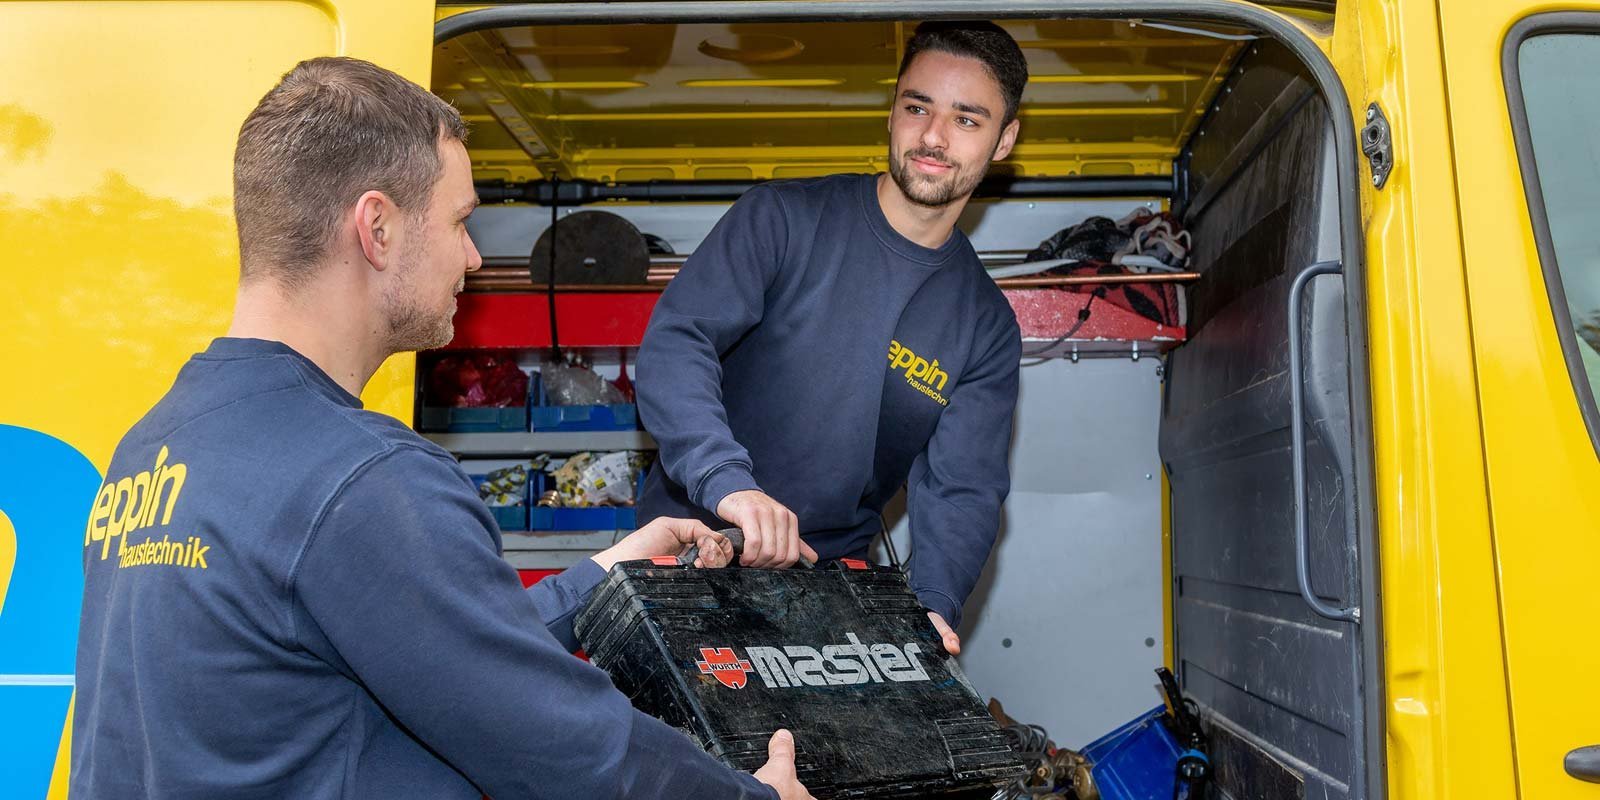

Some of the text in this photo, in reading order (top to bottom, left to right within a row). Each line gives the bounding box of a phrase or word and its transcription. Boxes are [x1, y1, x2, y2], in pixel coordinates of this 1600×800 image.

[887, 339, 949, 391] eppin
[906, 377, 949, 406] haustechni
[118, 534, 211, 569] haustechnik
[745, 632, 931, 688] master
